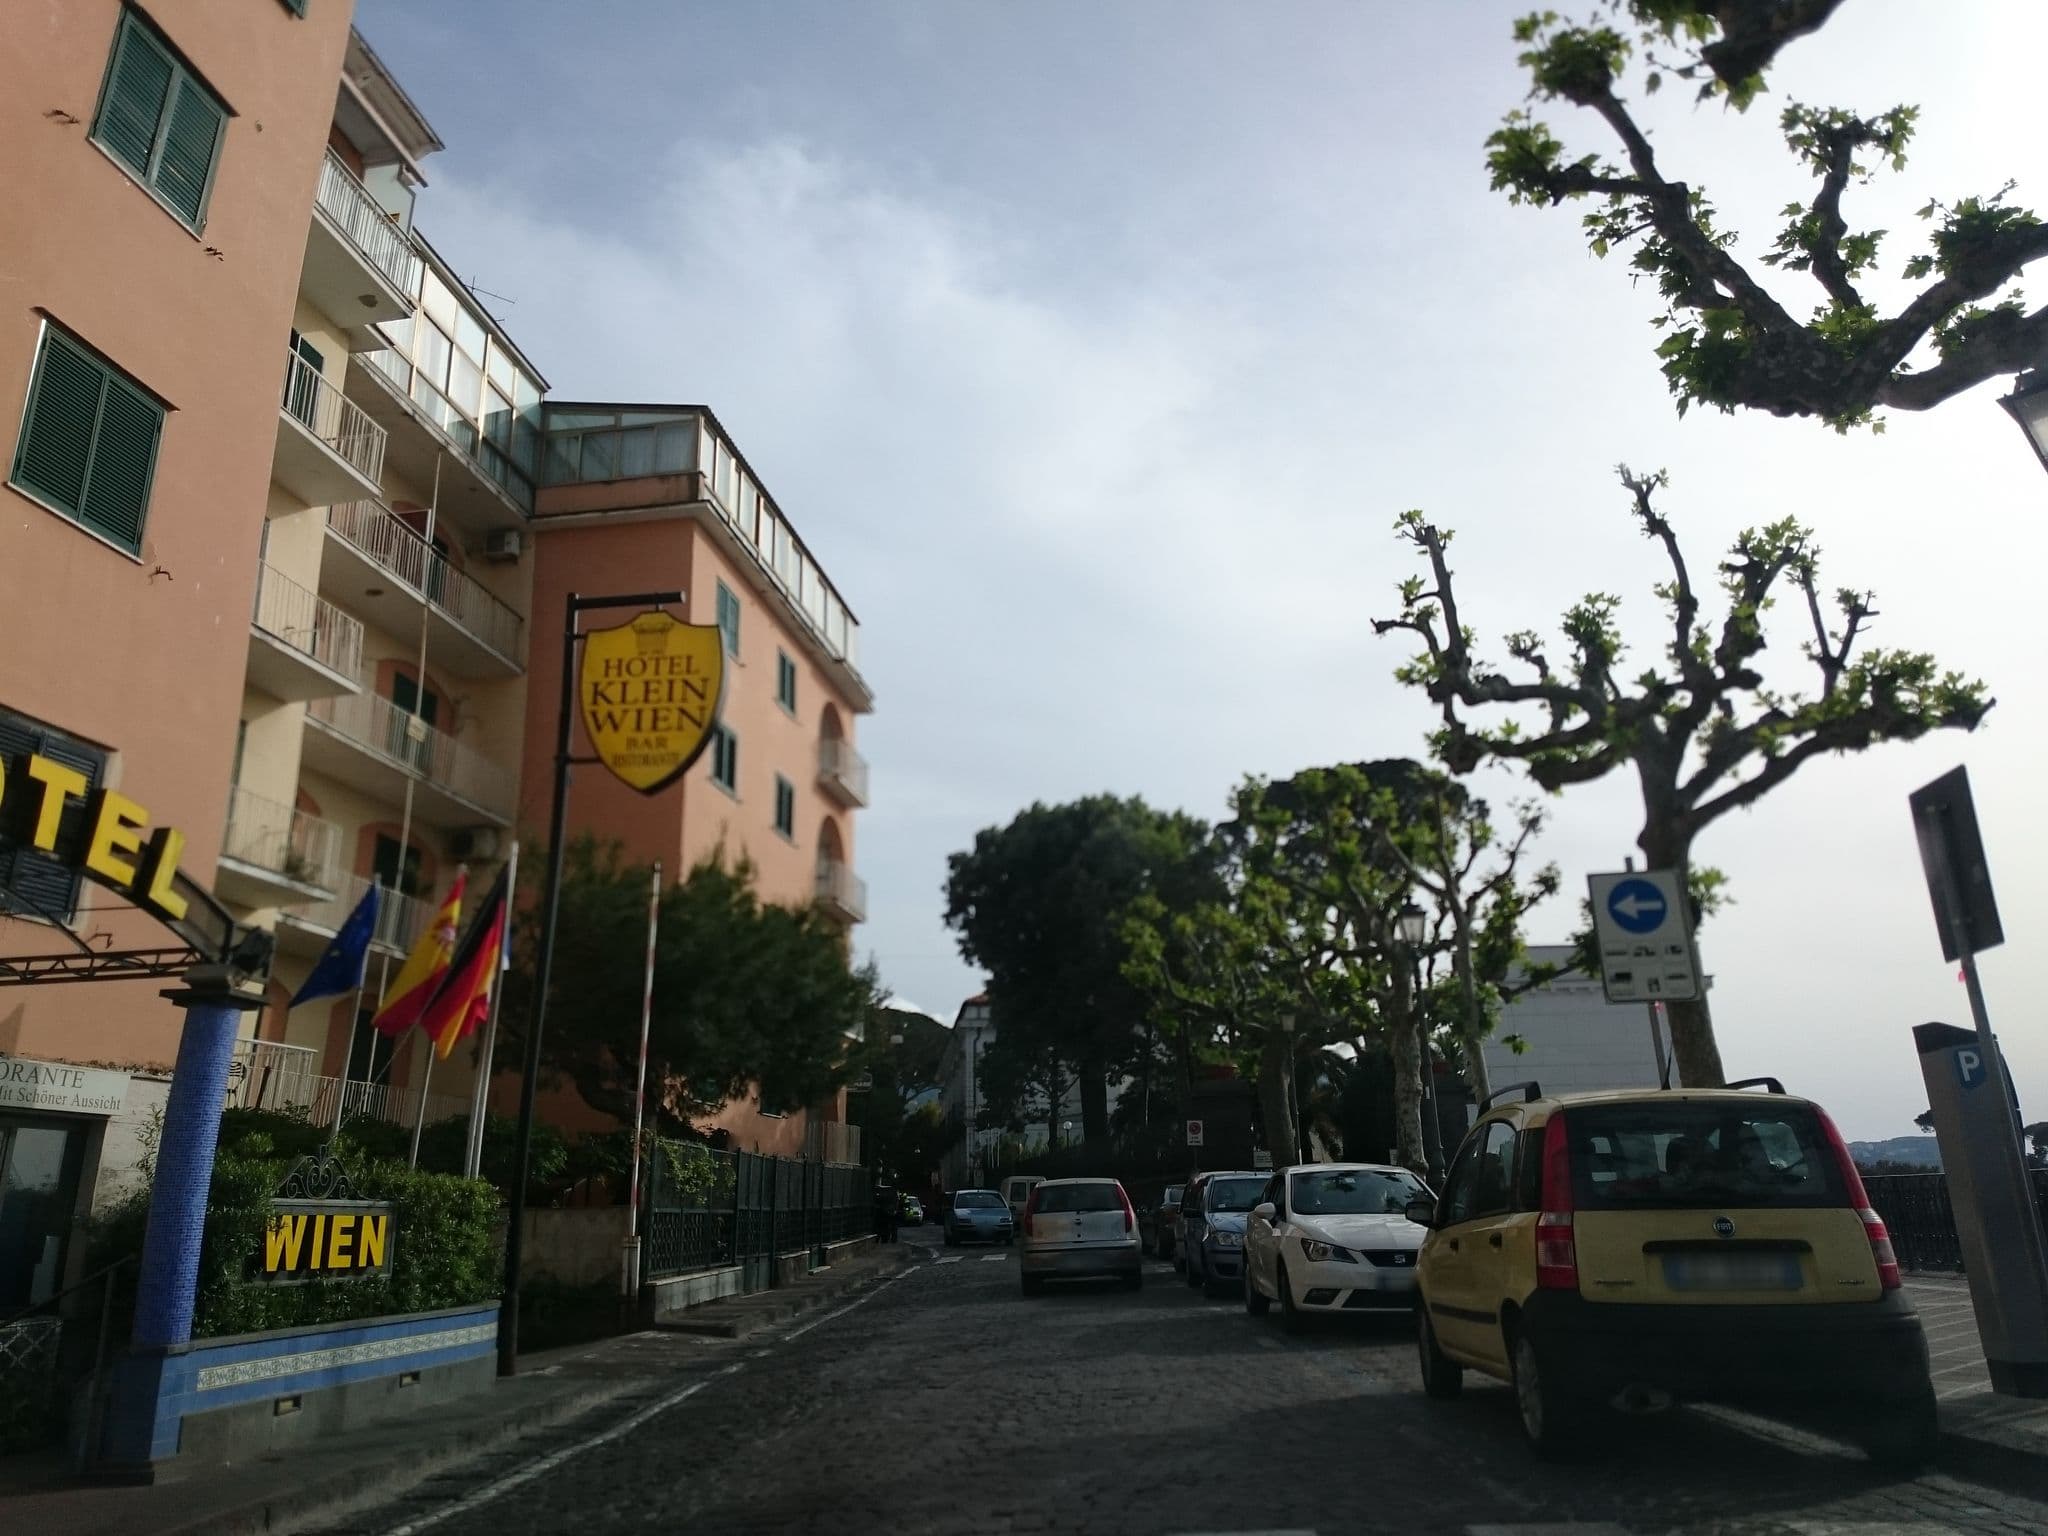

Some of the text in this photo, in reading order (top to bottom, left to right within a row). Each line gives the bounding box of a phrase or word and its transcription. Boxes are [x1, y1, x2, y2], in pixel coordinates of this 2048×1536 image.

[603, 655, 699, 678] HOTEL
[591, 677, 709, 705] KLEIN
[589, 704, 708, 733] WIEN
[626, 736, 668, 751] BAR
[0, 754, 189, 920] TEL
[1958, 1051, 1981, 1082] P
[17, 1087, 68, 1106] Schöner
[71, 1092, 121, 1111] Aussicht
[266, 1215, 387, 1271] WIEN
